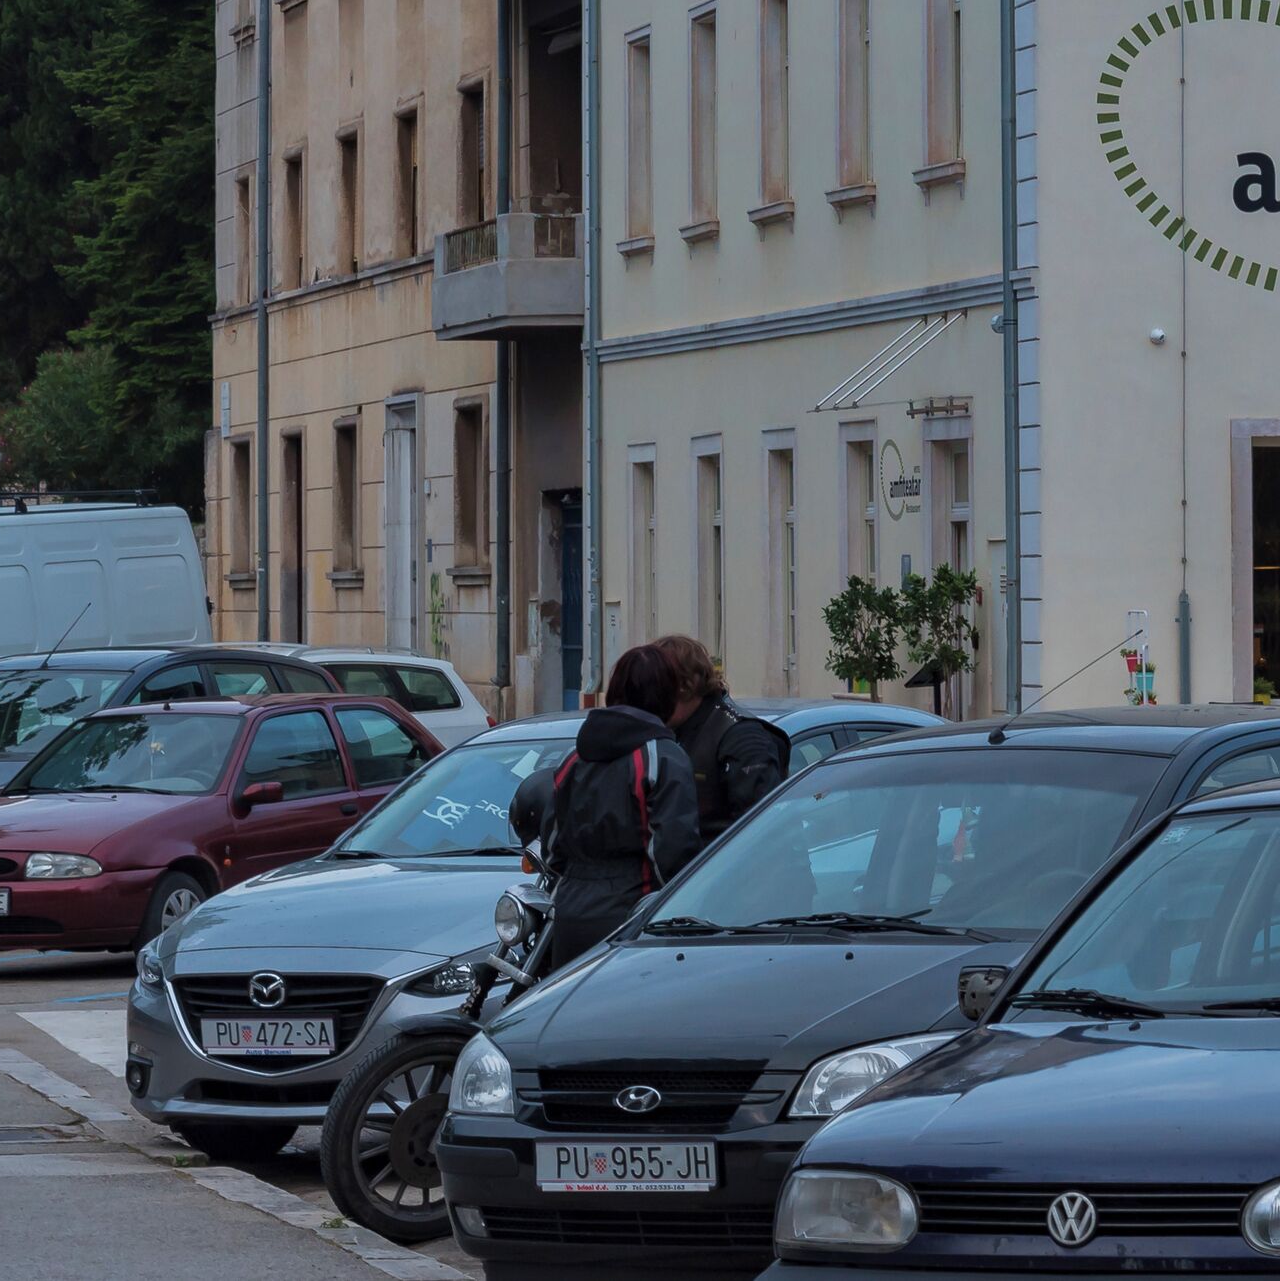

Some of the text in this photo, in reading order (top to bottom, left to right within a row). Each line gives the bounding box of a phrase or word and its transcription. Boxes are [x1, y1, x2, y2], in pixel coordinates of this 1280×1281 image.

[216, 1022, 330, 1046] PU 472-SA
[556, 1146, 711, 1180] PU 955-JH
